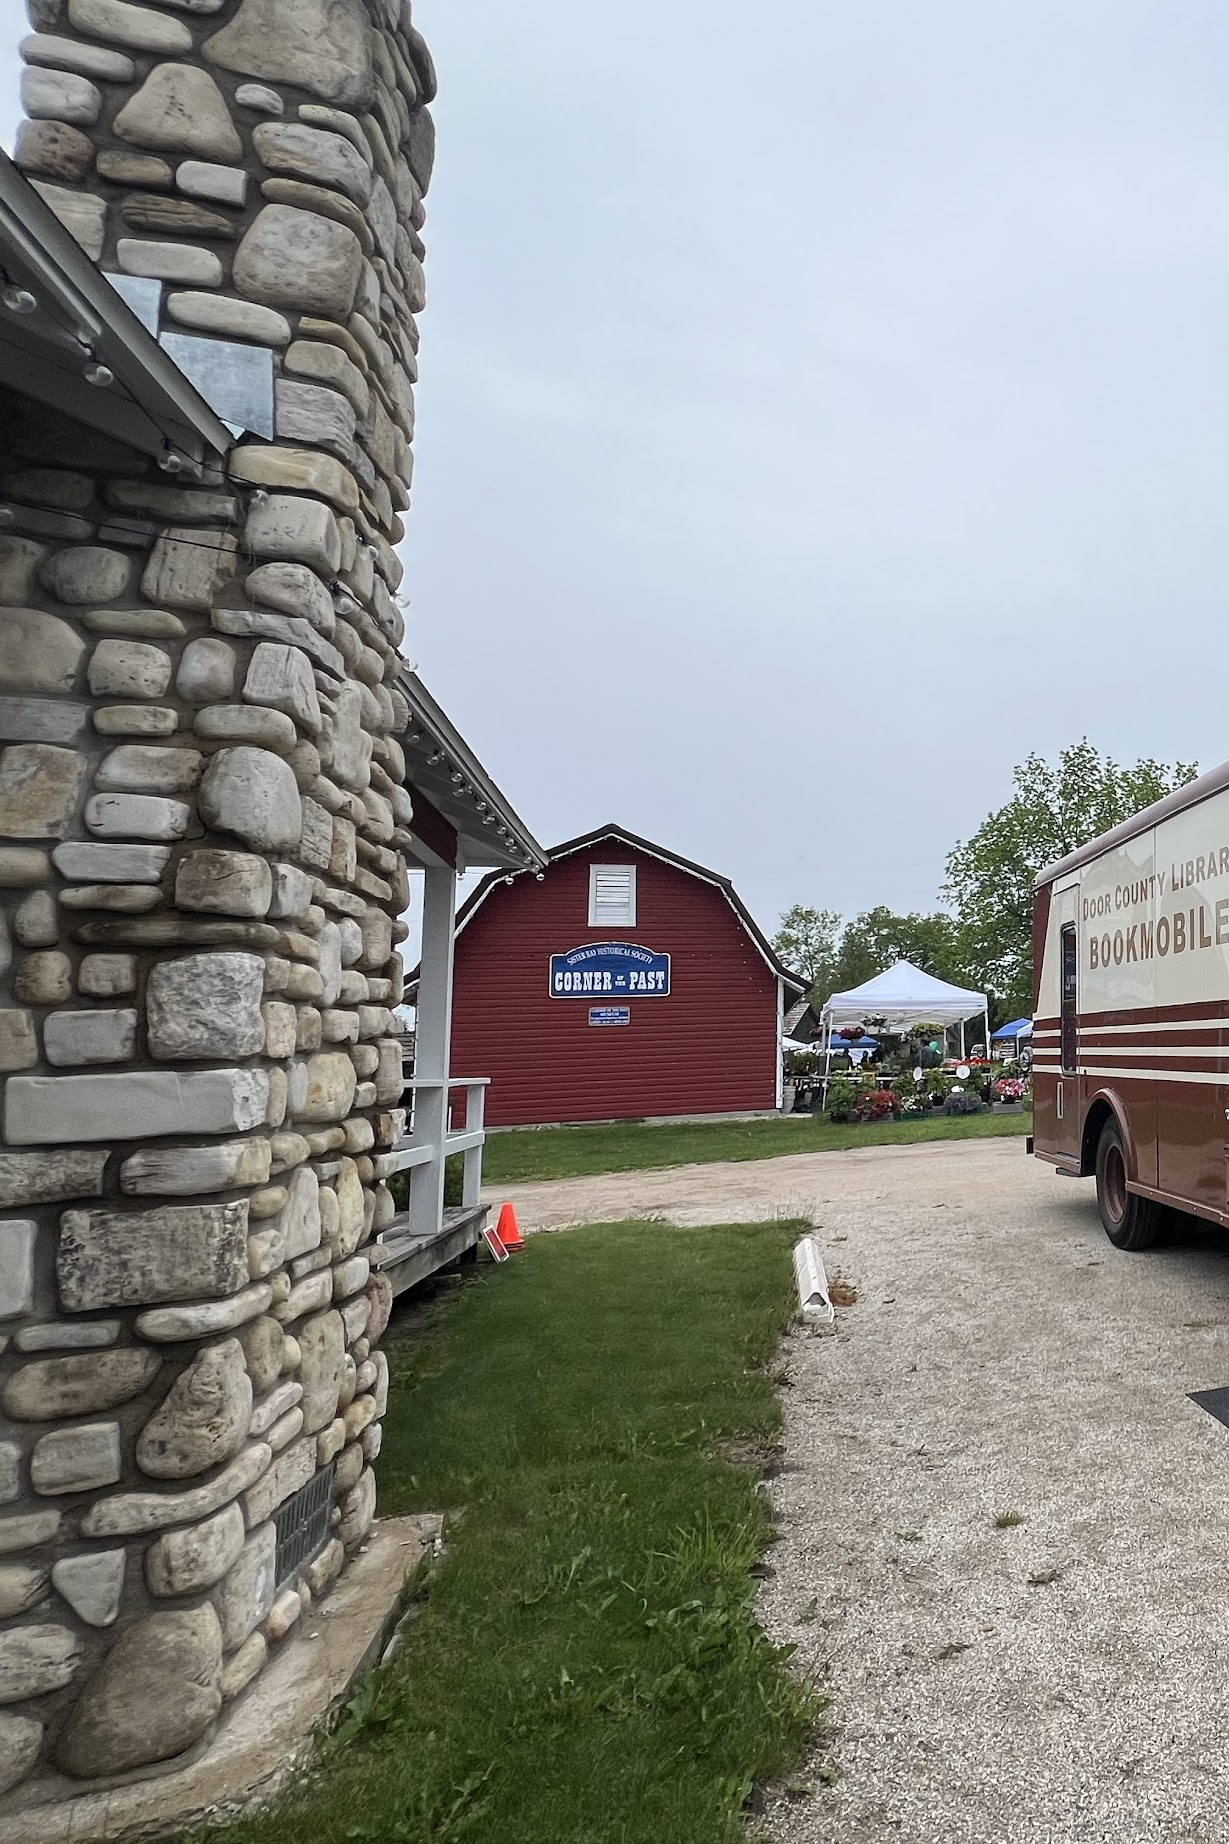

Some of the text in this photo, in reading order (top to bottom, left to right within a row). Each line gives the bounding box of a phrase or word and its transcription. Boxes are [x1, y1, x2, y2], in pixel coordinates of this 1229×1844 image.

[1083, 893, 1111, 921] DOOR
[1115, 871, 1166, 911] COUNTY
[1090, 898, 1229, 970] BOOKMOBILE
[554, 971, 613, 992] CORNER
[629, 970, 665, 991] PAST
